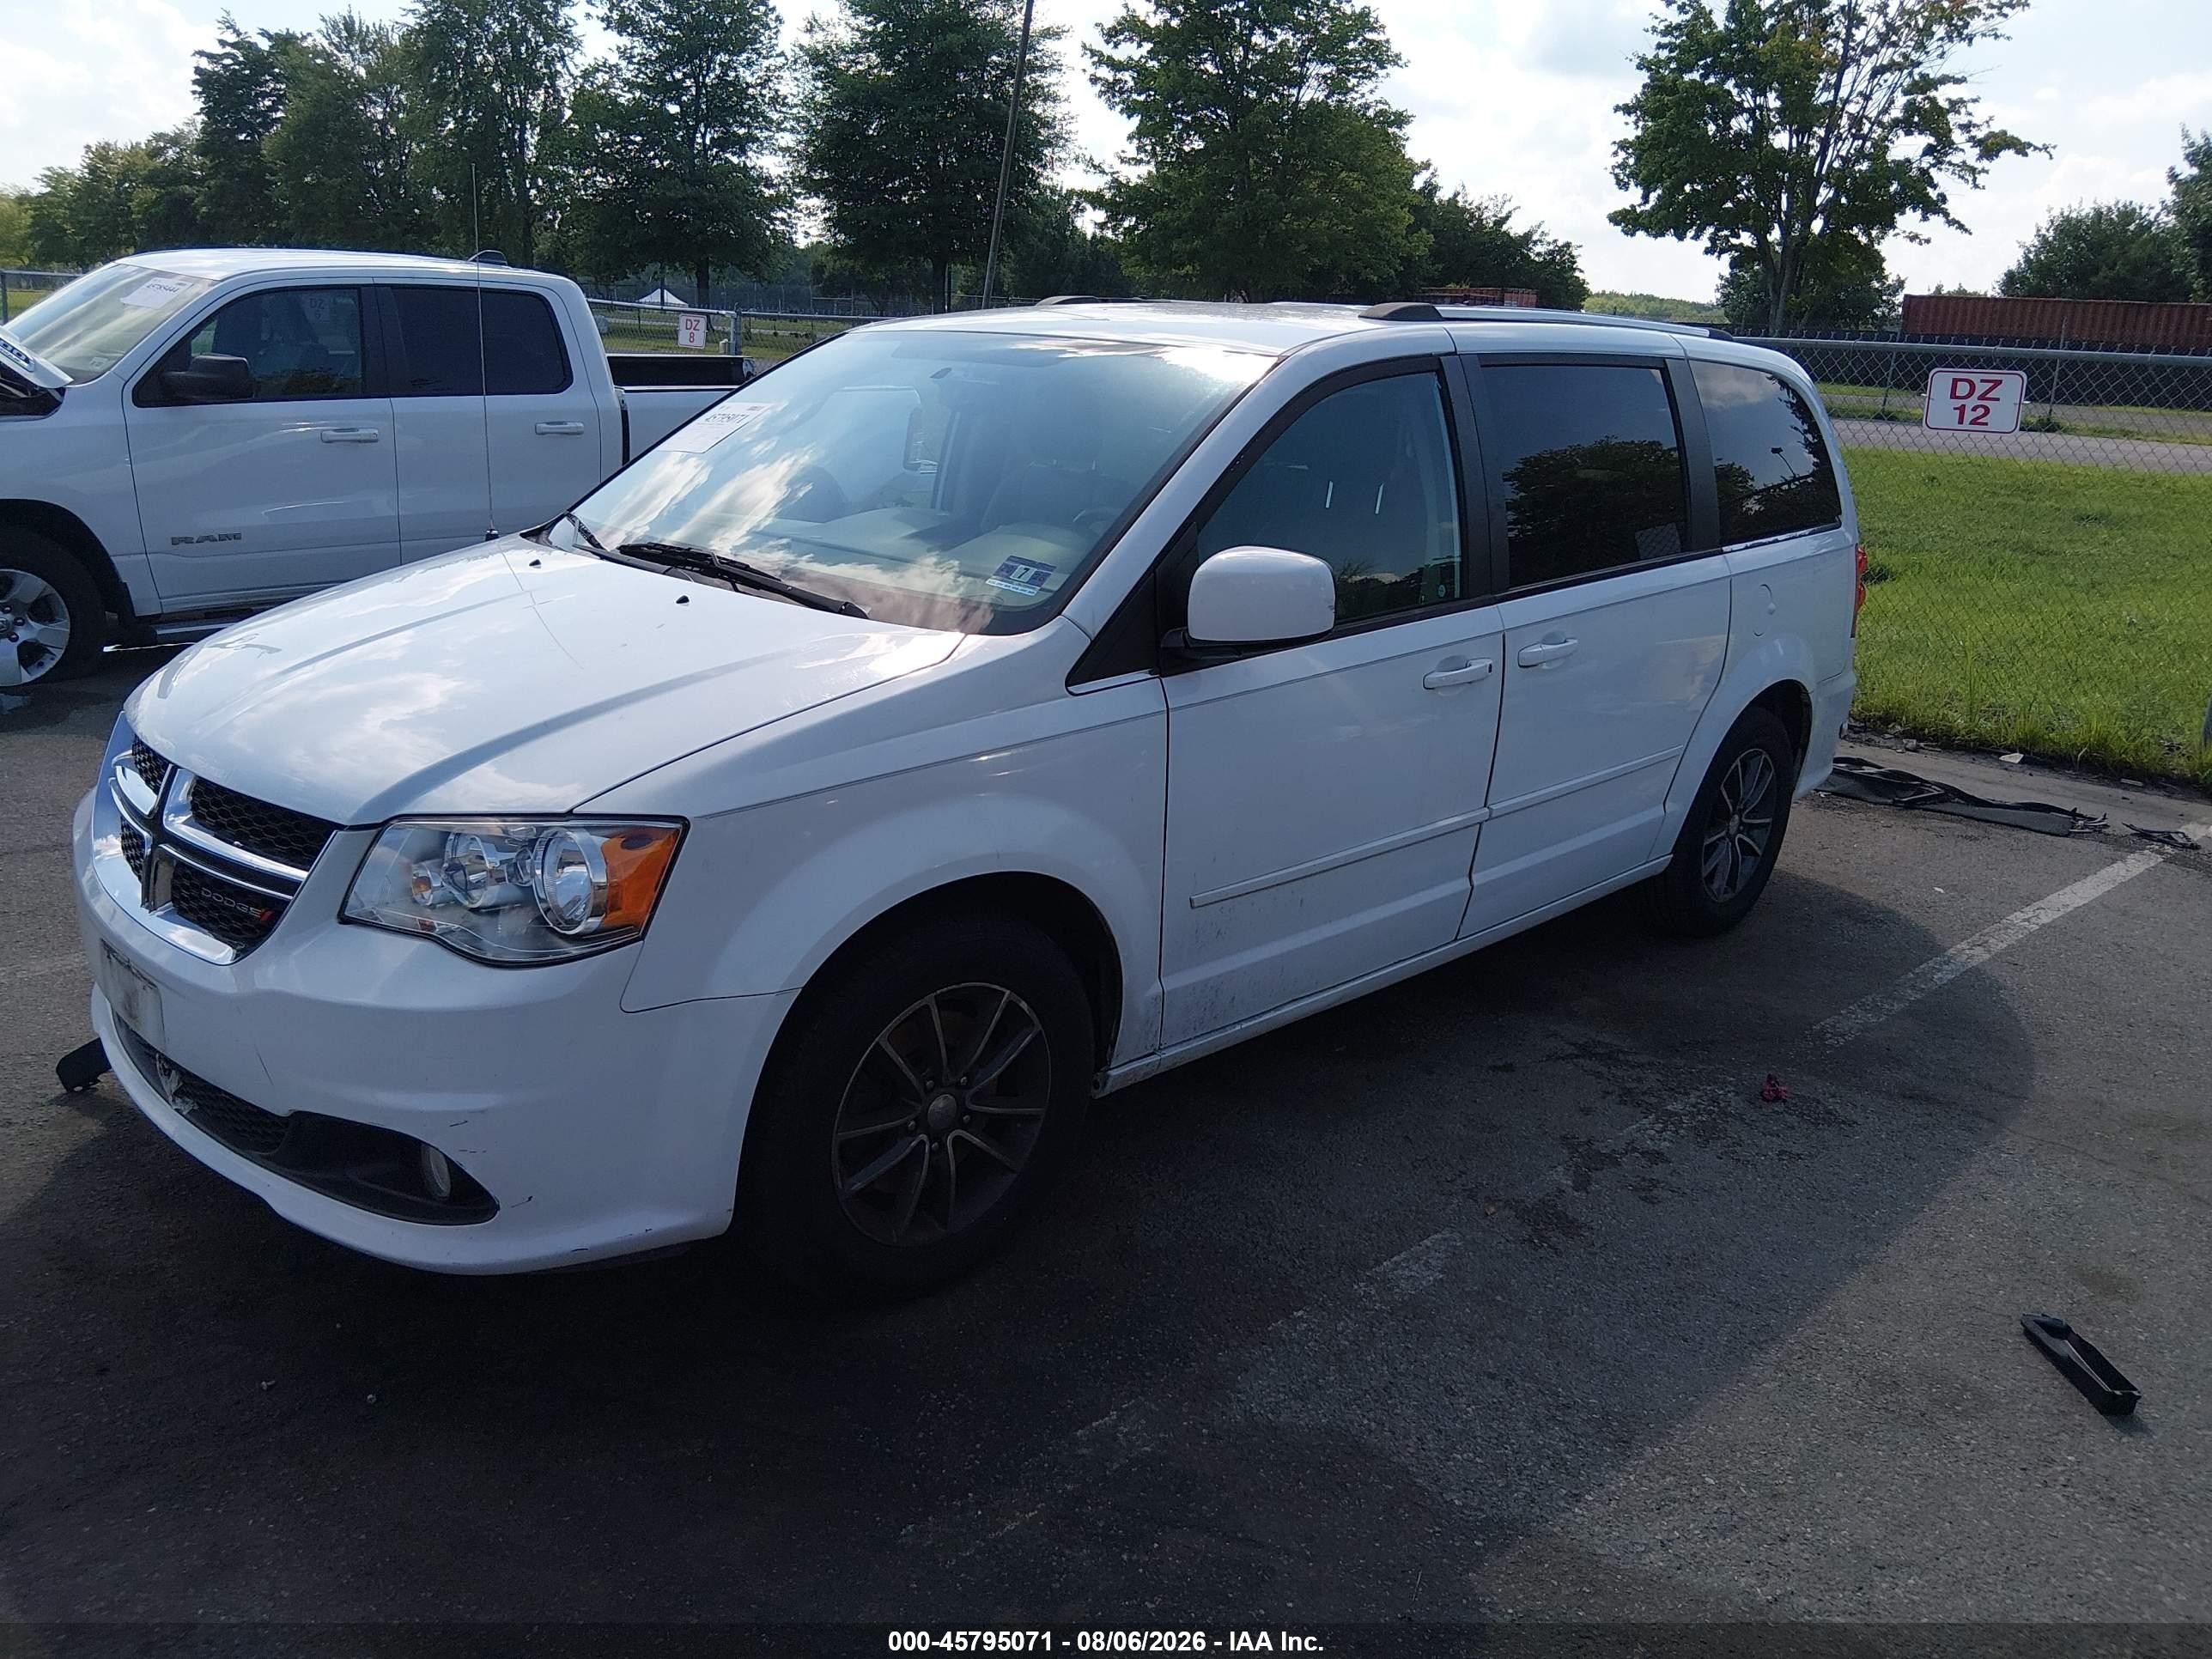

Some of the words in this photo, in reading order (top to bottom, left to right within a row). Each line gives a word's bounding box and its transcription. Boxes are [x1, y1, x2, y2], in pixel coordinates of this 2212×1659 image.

[685, 319, 701, 331] DZ
[689, 331, 696, 343] 8
[1949, 377, 2004, 402] DZ
[1952, 404, 1991, 427] 12
[171, 532, 242, 546] RAM
[1018, 568, 1030, 579] 7
[201, 886, 263, 919] DODGE
